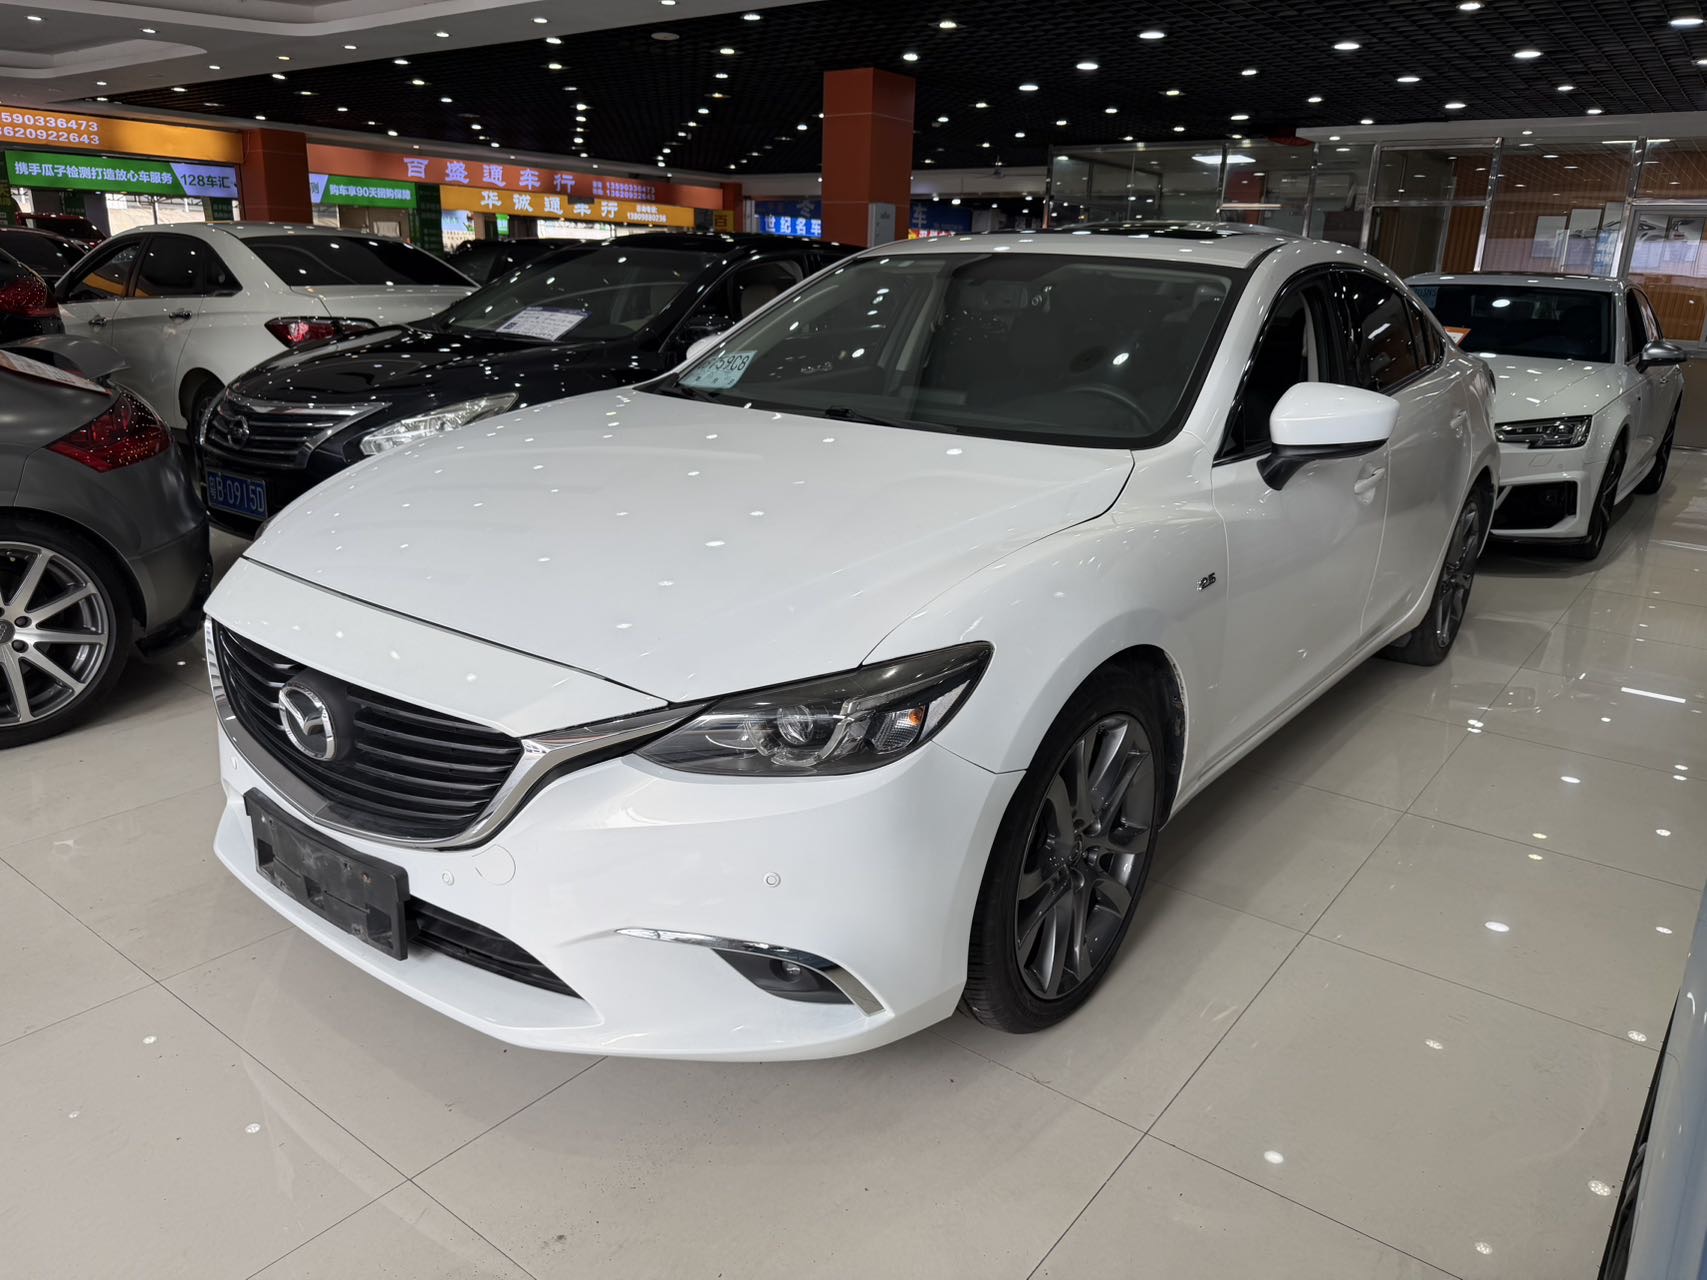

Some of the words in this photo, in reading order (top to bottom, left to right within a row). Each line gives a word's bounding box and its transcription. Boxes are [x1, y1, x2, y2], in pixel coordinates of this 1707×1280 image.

[0, 126, 101, 145] 620922643
[180, 173, 231, 189] 128车汇
[402, 157, 576, 194] 百盛通车行
[765, 214, 822, 236] 世纪名车
